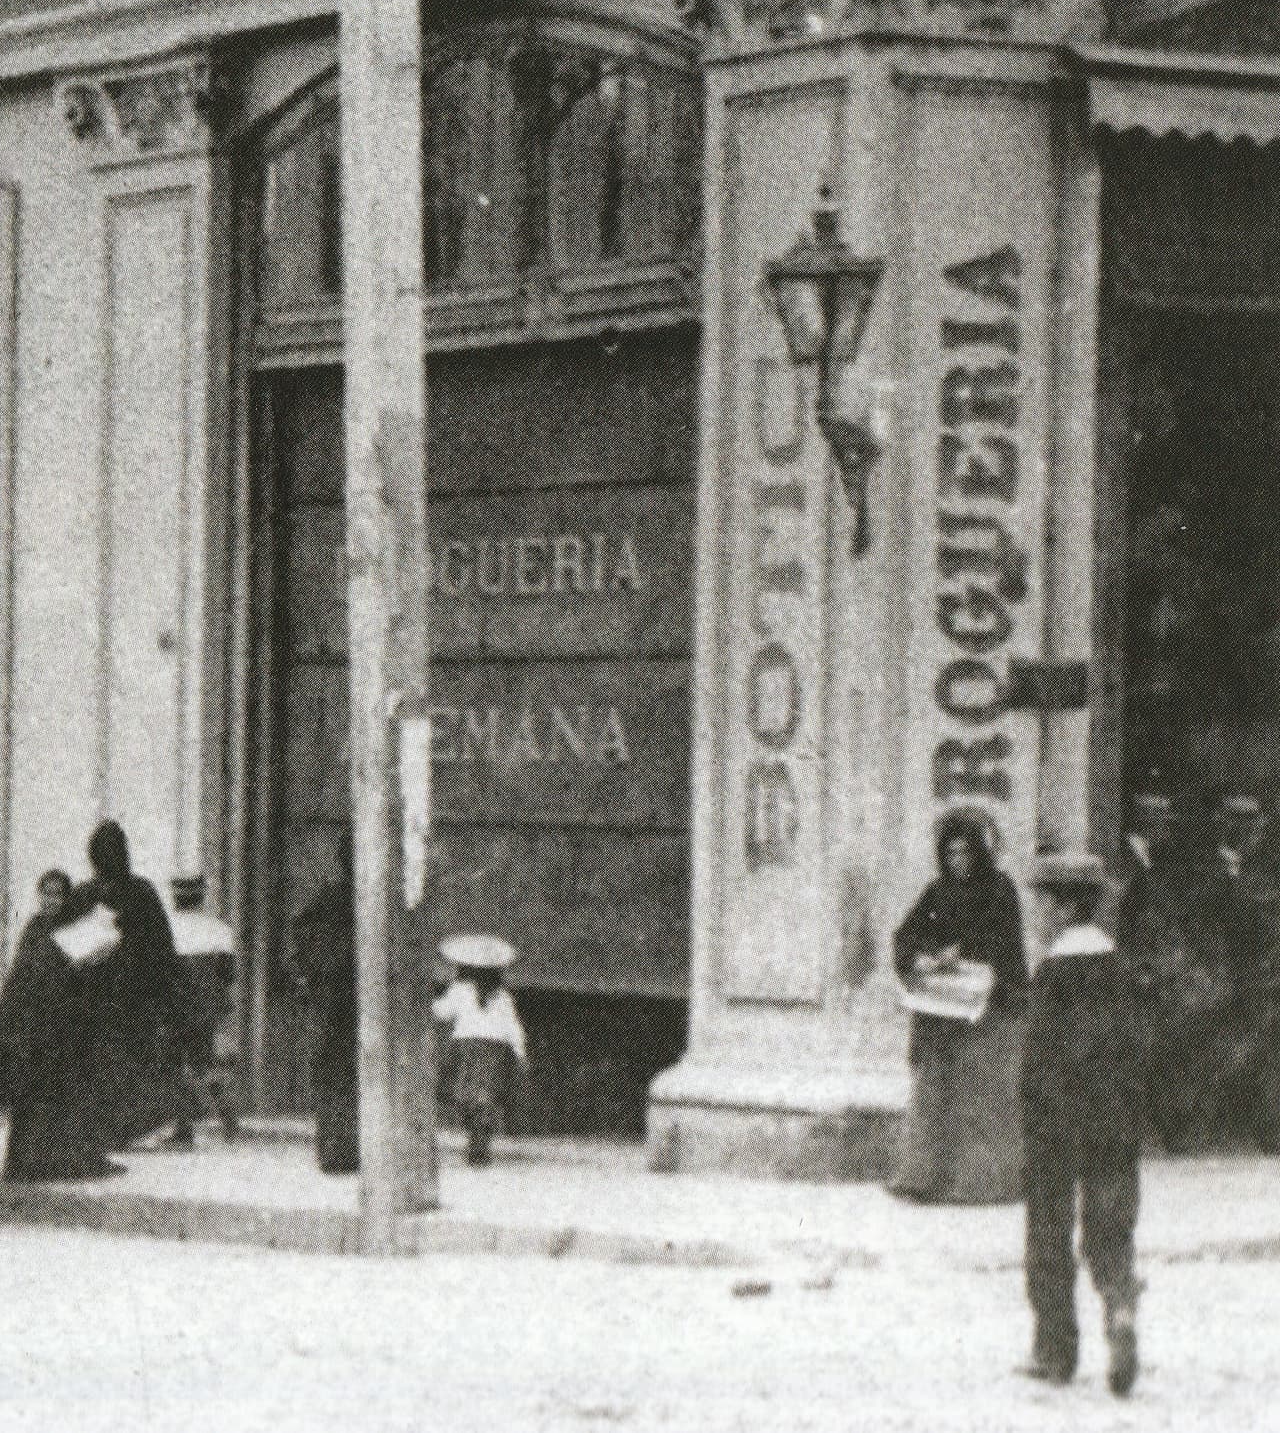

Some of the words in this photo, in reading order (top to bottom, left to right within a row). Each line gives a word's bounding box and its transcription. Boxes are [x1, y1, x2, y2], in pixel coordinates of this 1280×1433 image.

[436, 530, 646, 598] GUERIA
[741, 356, 807, 874] BOTIC
[427, 704, 632, 764] EMANA
